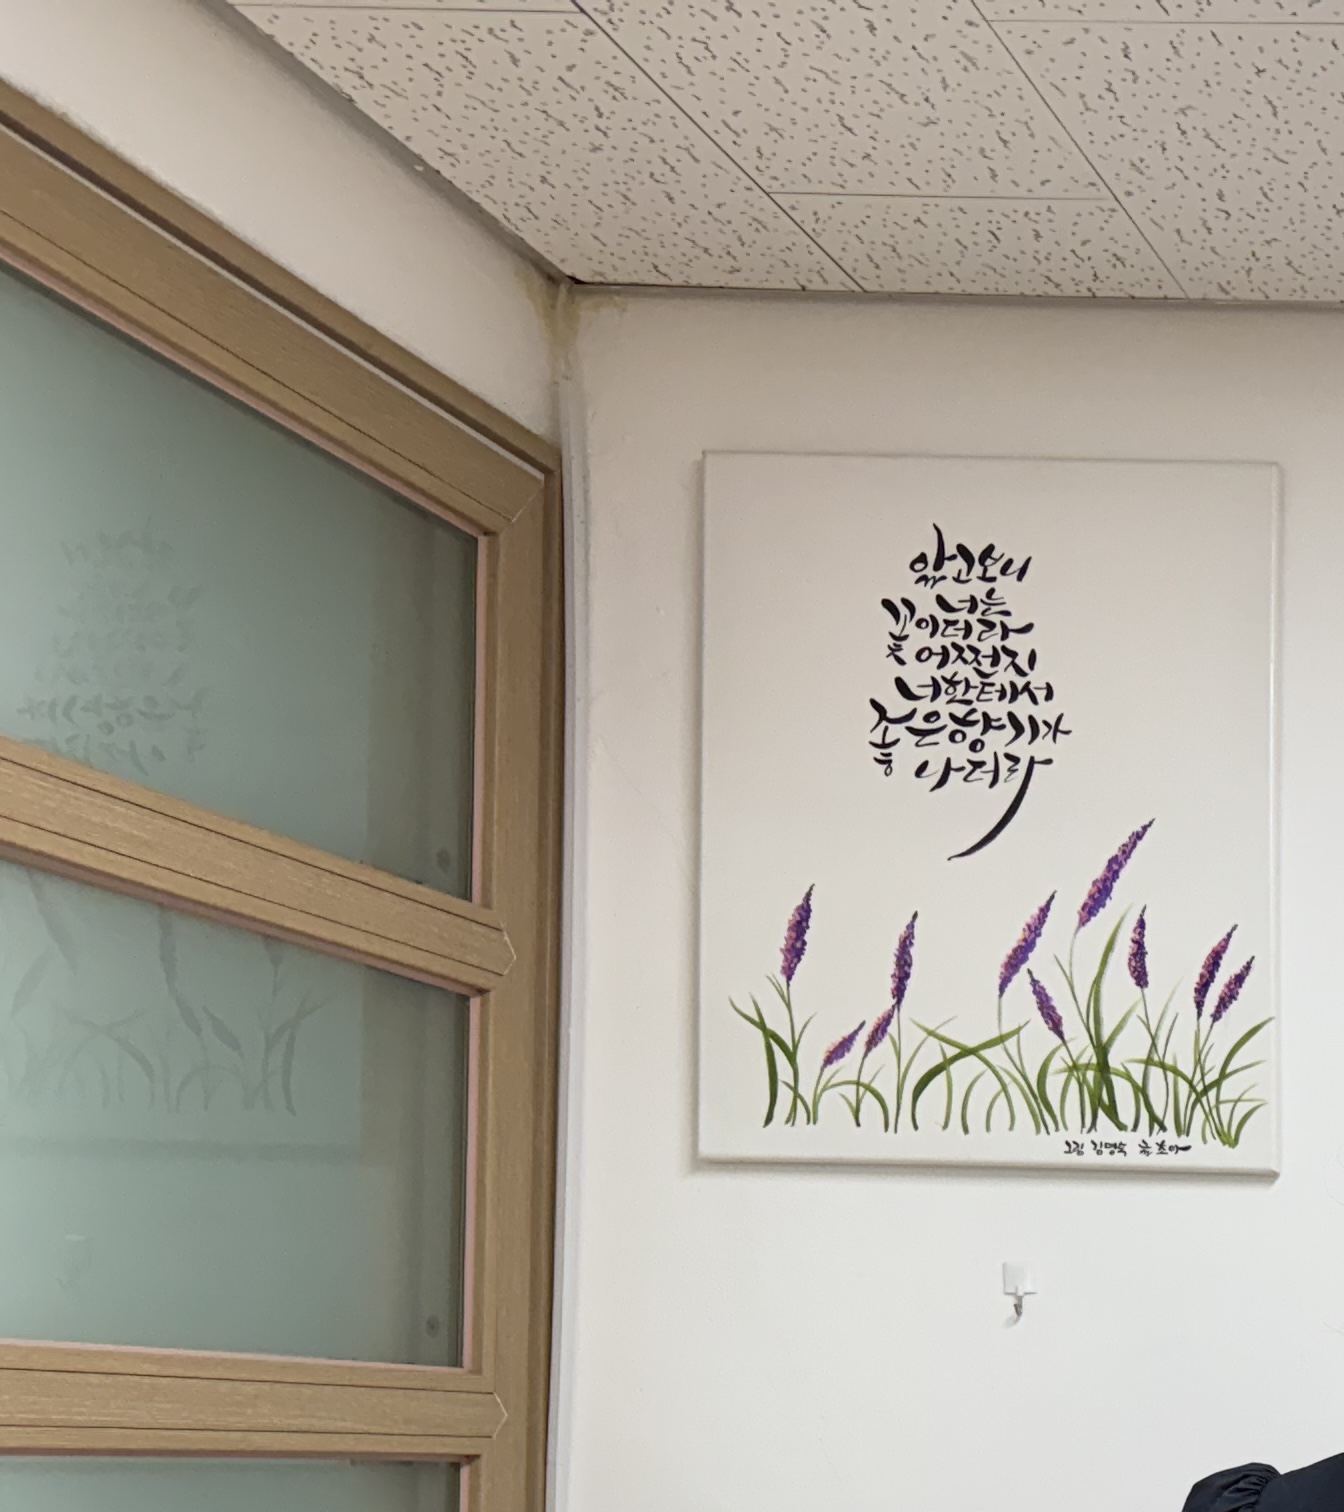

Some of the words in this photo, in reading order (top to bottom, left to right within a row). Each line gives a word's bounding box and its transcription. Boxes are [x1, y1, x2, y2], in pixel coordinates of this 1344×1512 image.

[935, 587, 1012, 617] 너는
[881, 597, 1035, 666] 꽃이더라
[915, 642, 1037, 679] 어쩐지
[894, 671, 1054, 706] 너한테서
[1064, 1140, 1085, 1156] 그림
